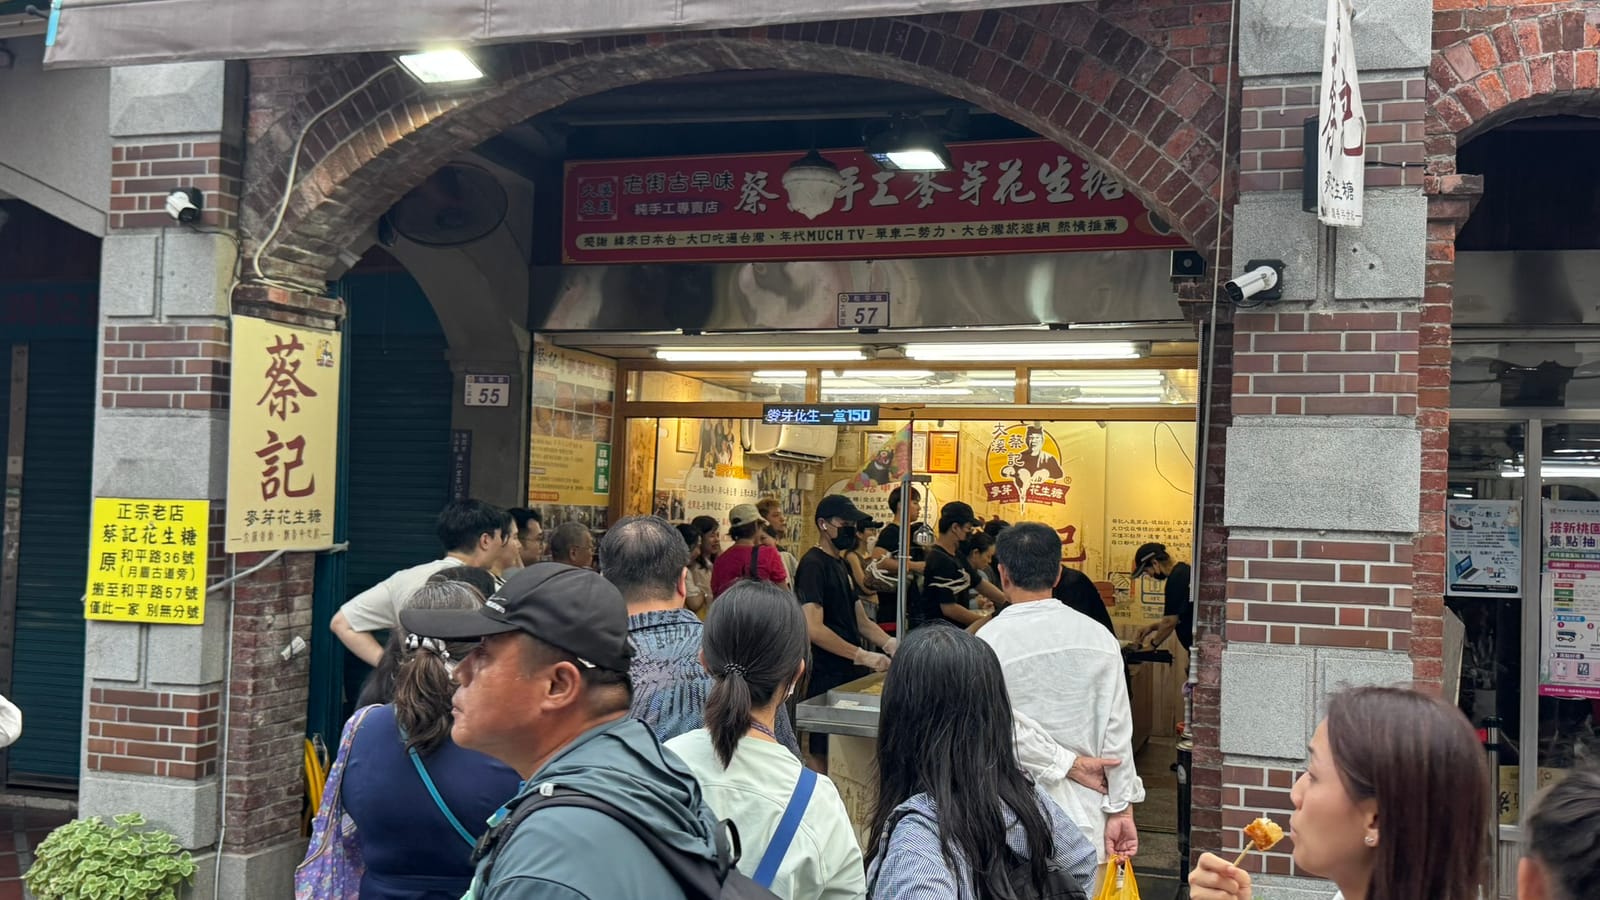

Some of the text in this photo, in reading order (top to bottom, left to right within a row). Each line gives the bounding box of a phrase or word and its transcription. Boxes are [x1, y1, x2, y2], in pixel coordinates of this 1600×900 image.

[623, 170, 736, 195] 老街古早味
[734, 155, 1127, 215] 蔡手工麥芽花生糖
[633, 200, 720, 216] 純手工專賣店
[854, 307, 878, 324] 57
[478, 388, 501, 404] 55
[255, 334, 317, 501] 蔡記
[991, 421, 1008, 454] 大溪
[1008, 434, 1025, 467] 蔡記
[117, 503, 184, 521] 正宗老店
[244, 508, 323, 526] 麥芽花生糖
[103, 524, 198, 546] 蔡記花生糖
[1550, 535, 1595, 548] 集點抽
[99, 551, 117, 572] 原
[121, 549, 195, 565] 和平路36號
[92, 582, 199, 601] 搬至和平路57號
[90, 601, 200, 620] 僅此一家 別無分號
